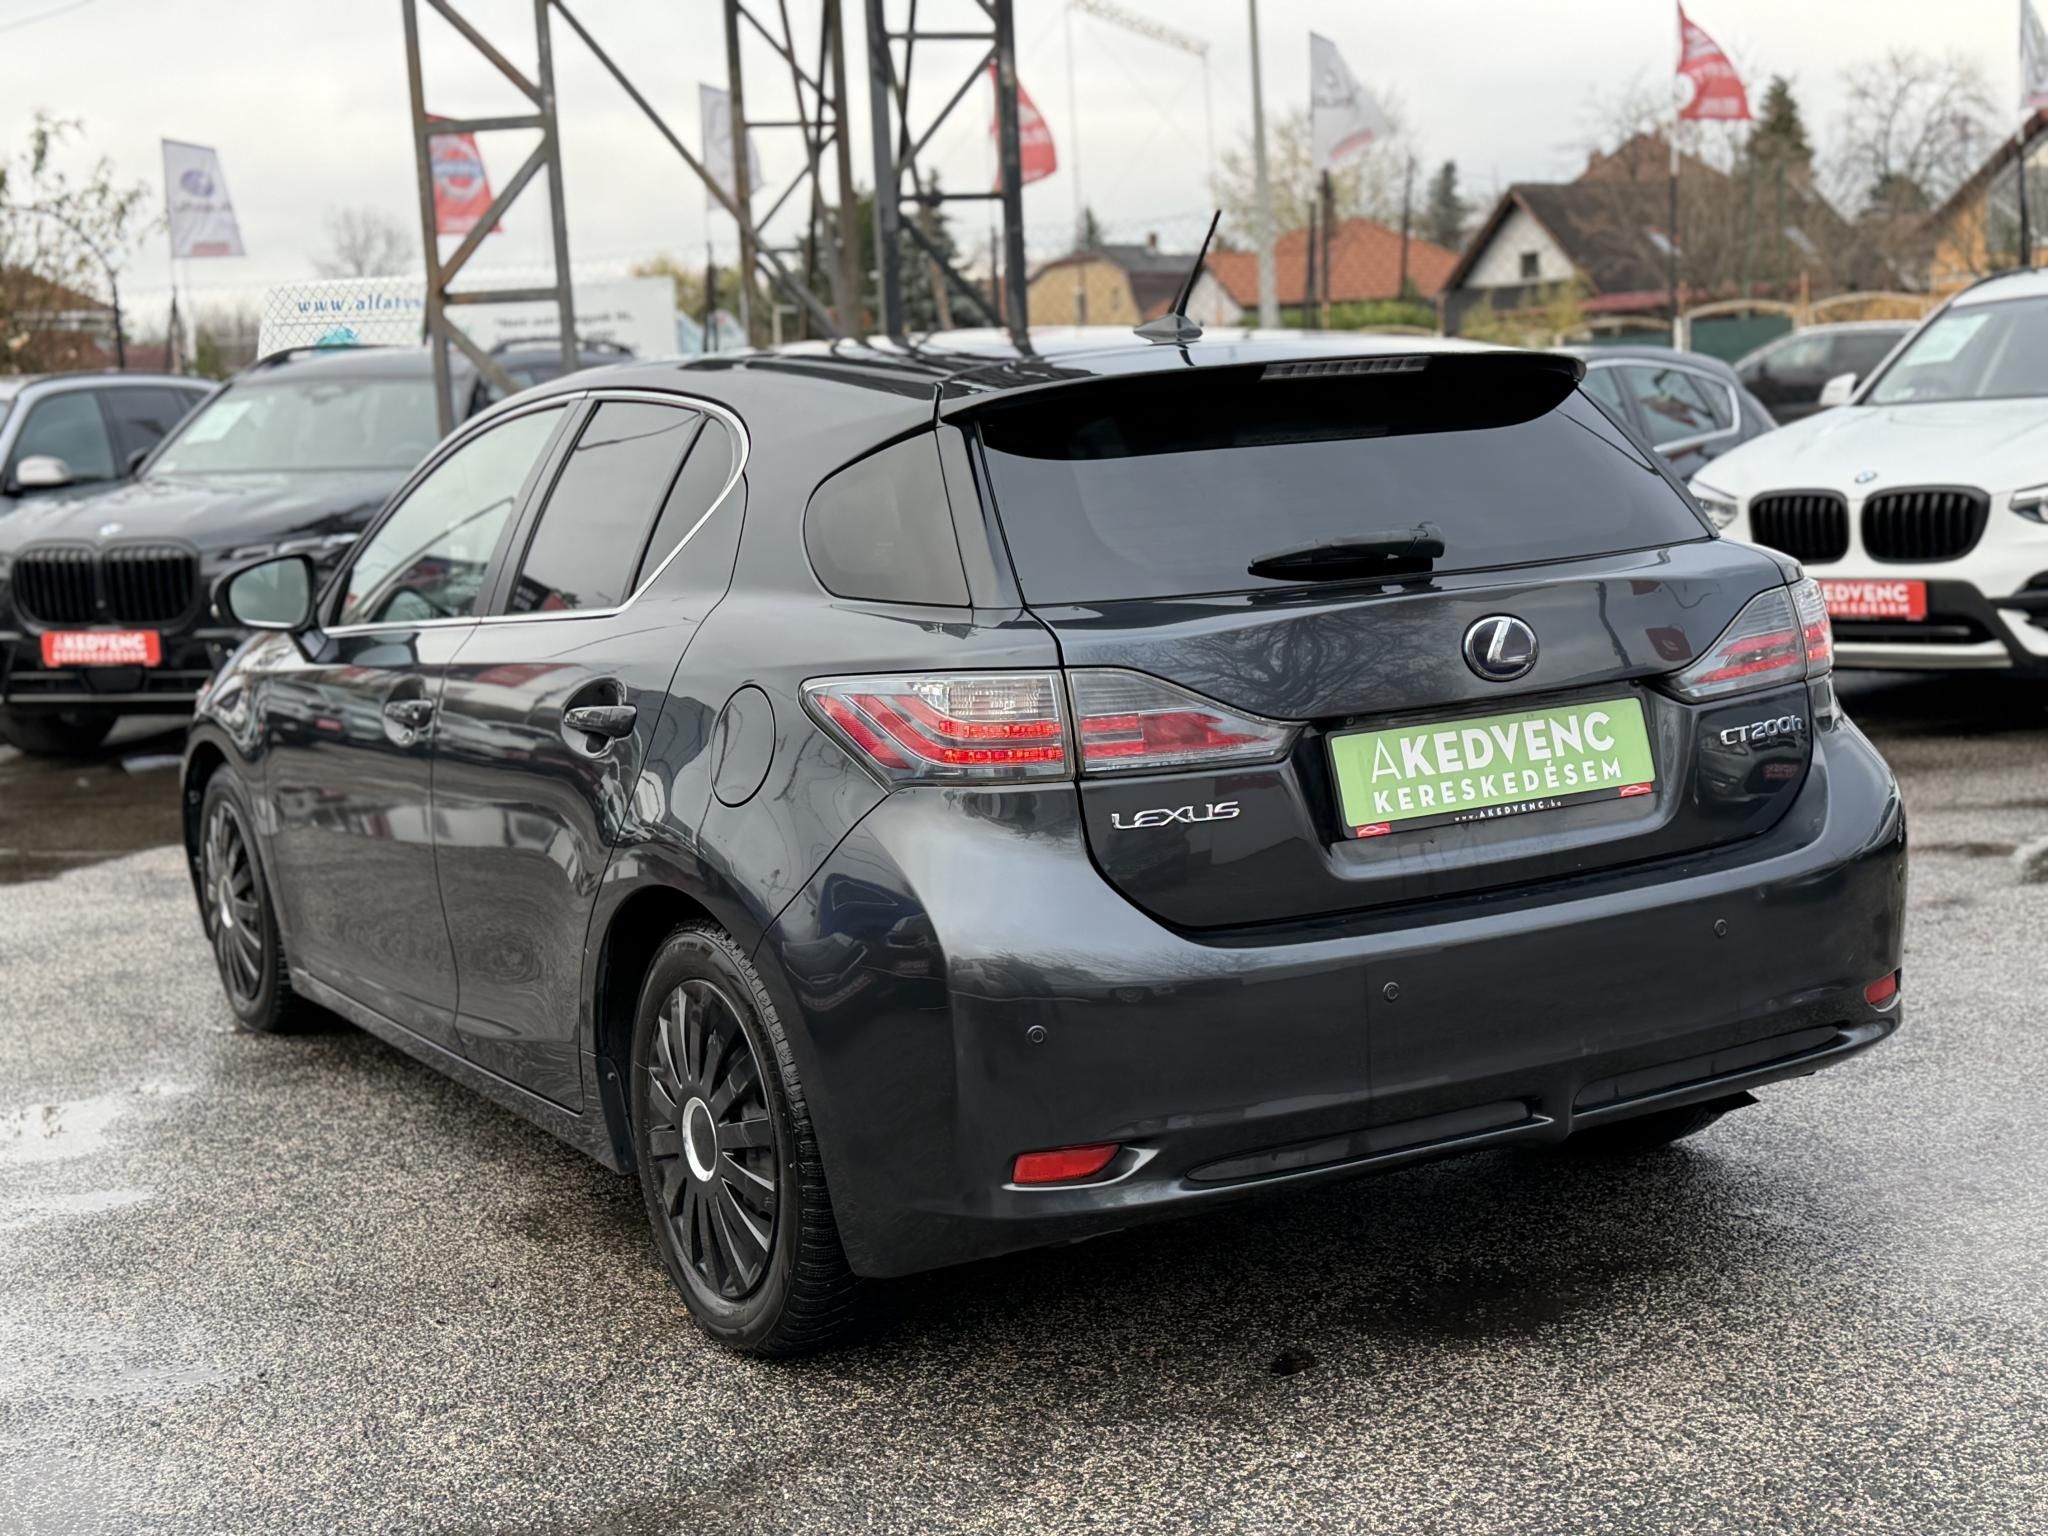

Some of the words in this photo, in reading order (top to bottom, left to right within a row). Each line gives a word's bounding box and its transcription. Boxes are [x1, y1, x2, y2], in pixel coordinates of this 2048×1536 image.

[1821, 583, 1909, 603] EDVENC
[1371, 711, 1615, 784] AKEDVENC
[1373, 756, 1622, 814] KERESKEDÉSEM
[1111, 800, 1240, 830] LEXUS
